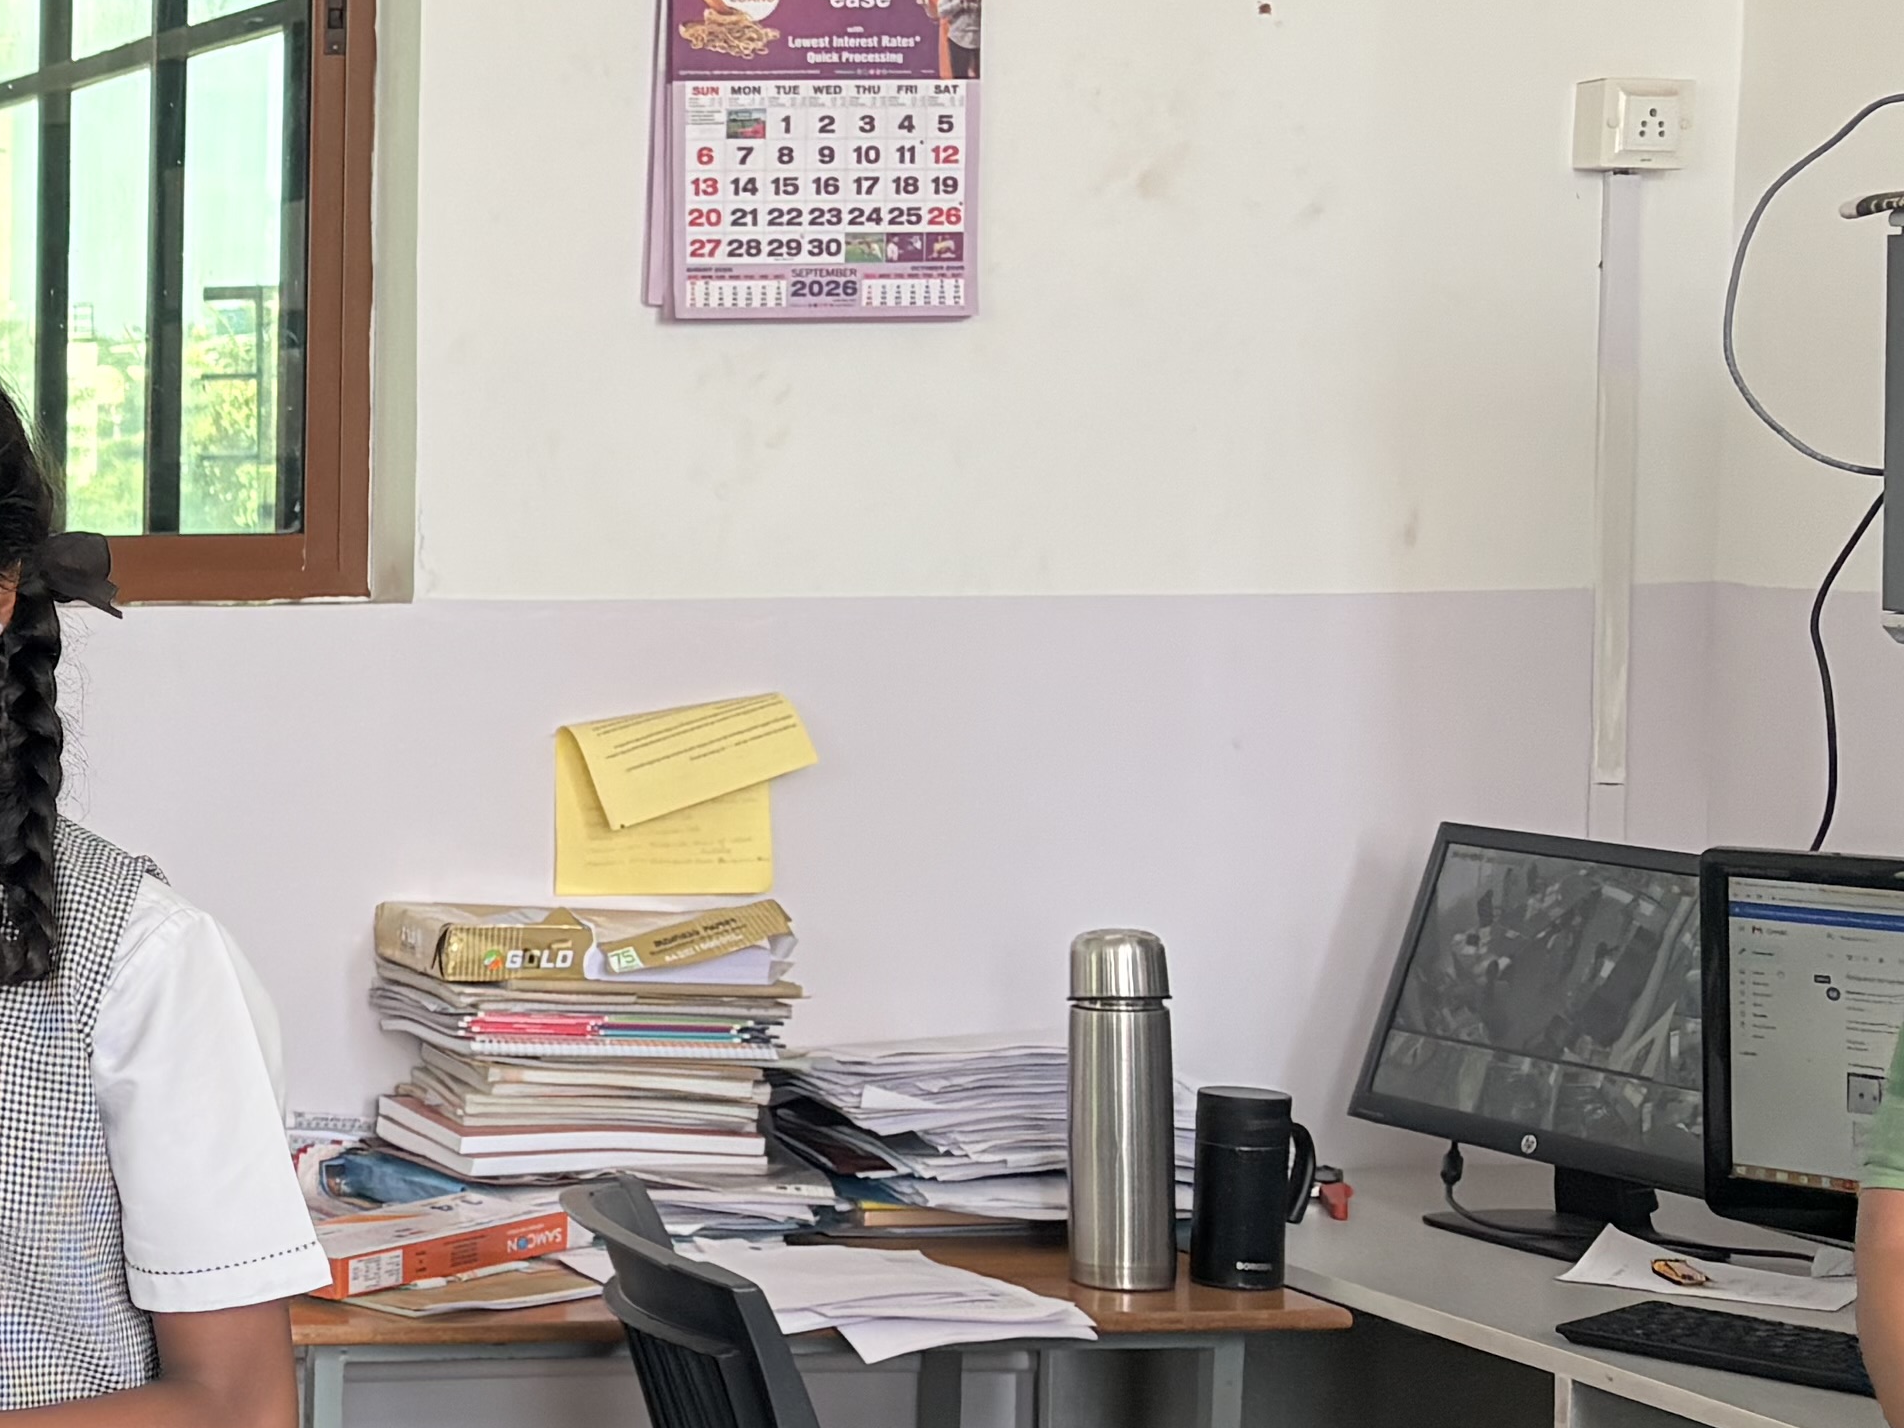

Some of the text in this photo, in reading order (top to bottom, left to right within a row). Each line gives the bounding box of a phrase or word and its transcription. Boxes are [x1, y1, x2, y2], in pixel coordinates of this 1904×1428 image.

[788, 35, 830, 48] Lowest
[832, 35, 879, 48] Interest
[807, 52, 903, 65] Quick Processing
[692, 84, 959, 96] SUN MON TUE WED THU FRI SAT
[780, 114, 954, 134] 1 2 3 4 5
[696, 145, 959, 165] 6 7 8 9 10 11 12
[691, 176, 958, 196] 13 14 15 16 17 18 19
[688, 206, 962, 227] 20 21 22 23 24 25 26
[689, 238, 842, 258] 27 28 29 30
[791, 267, 857, 278] SEPTEMBER
[790, 279, 858, 298] 2026
[610, 950, 636, 965] 75
